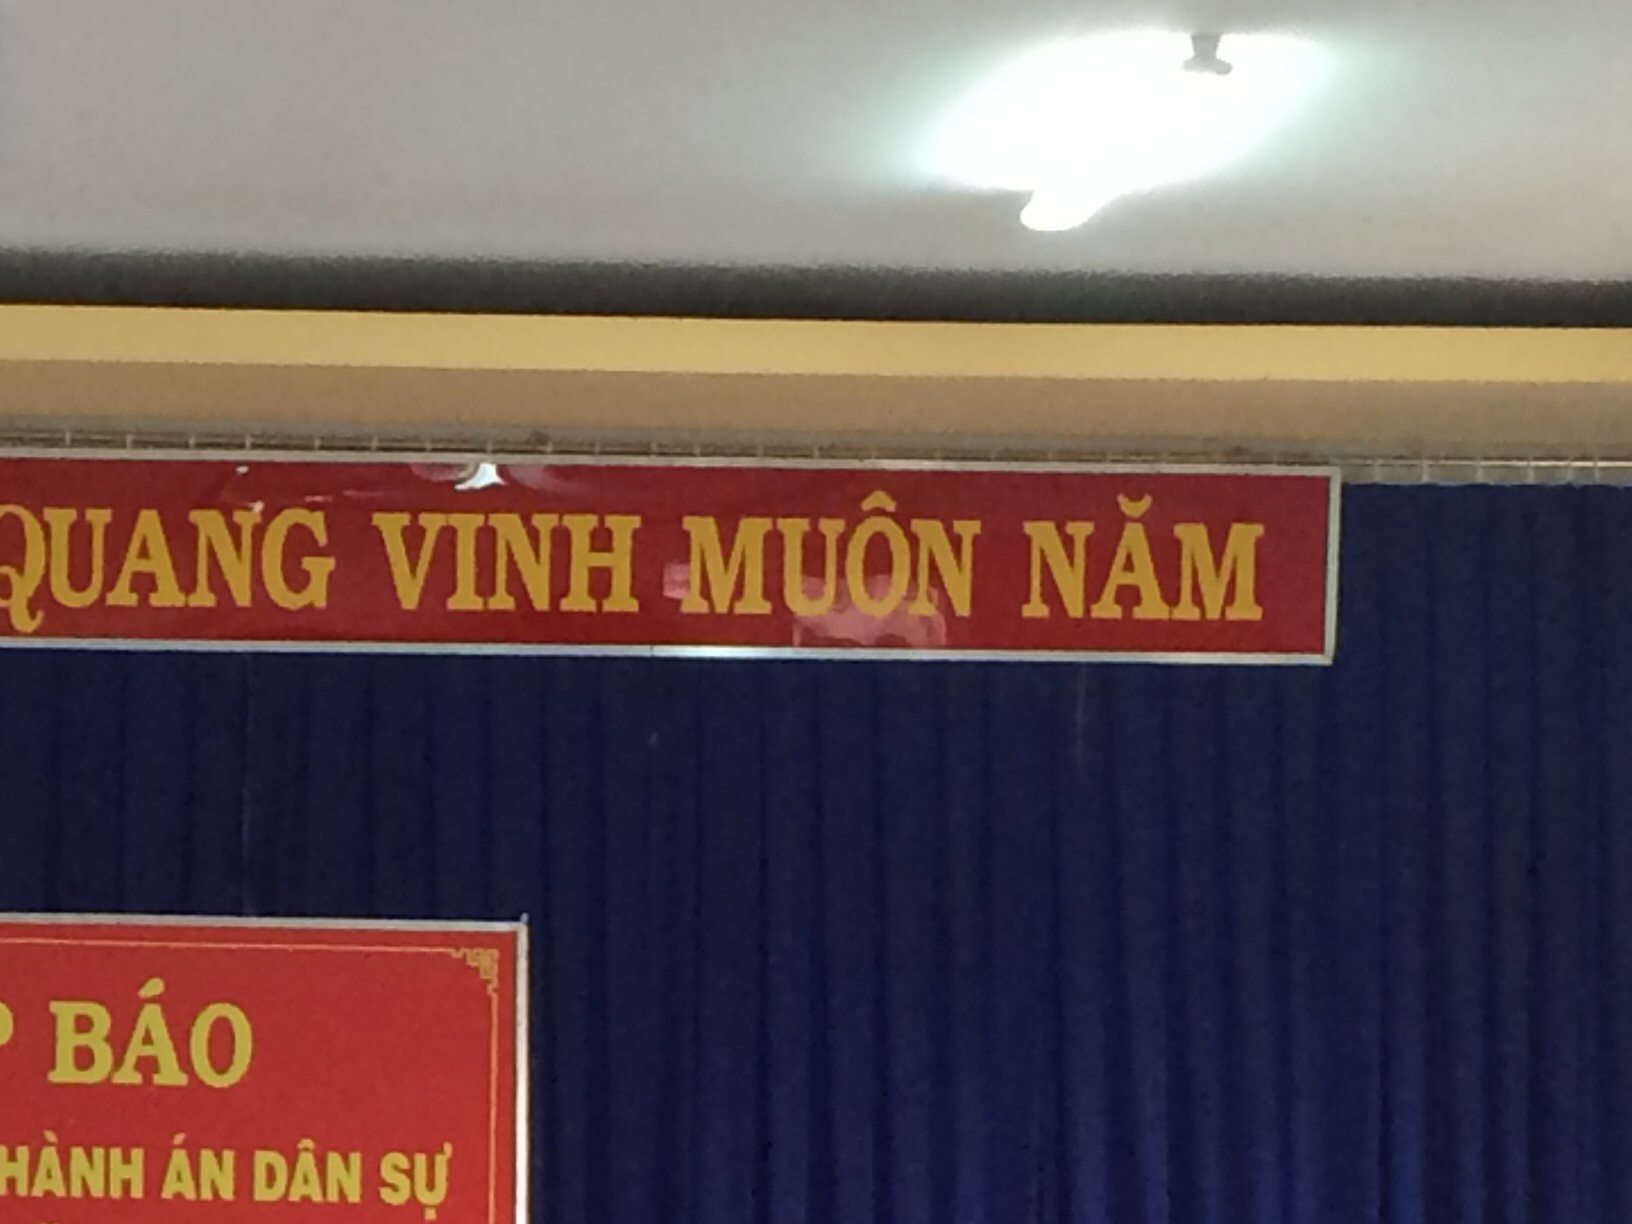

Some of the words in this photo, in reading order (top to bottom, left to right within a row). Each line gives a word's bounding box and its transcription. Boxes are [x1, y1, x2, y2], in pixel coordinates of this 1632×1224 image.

[372, 512, 642, 612] VINH
[681, 490, 981, 616] MUÔN
[1022, 494, 1264, 621] NĂM
[47, 977, 254, 1089] BÁO
[161, 1132, 236, 1202] ÁN
[252, 1137, 363, 1204] DÂN
[379, 1142, 452, 1221] SỰ
